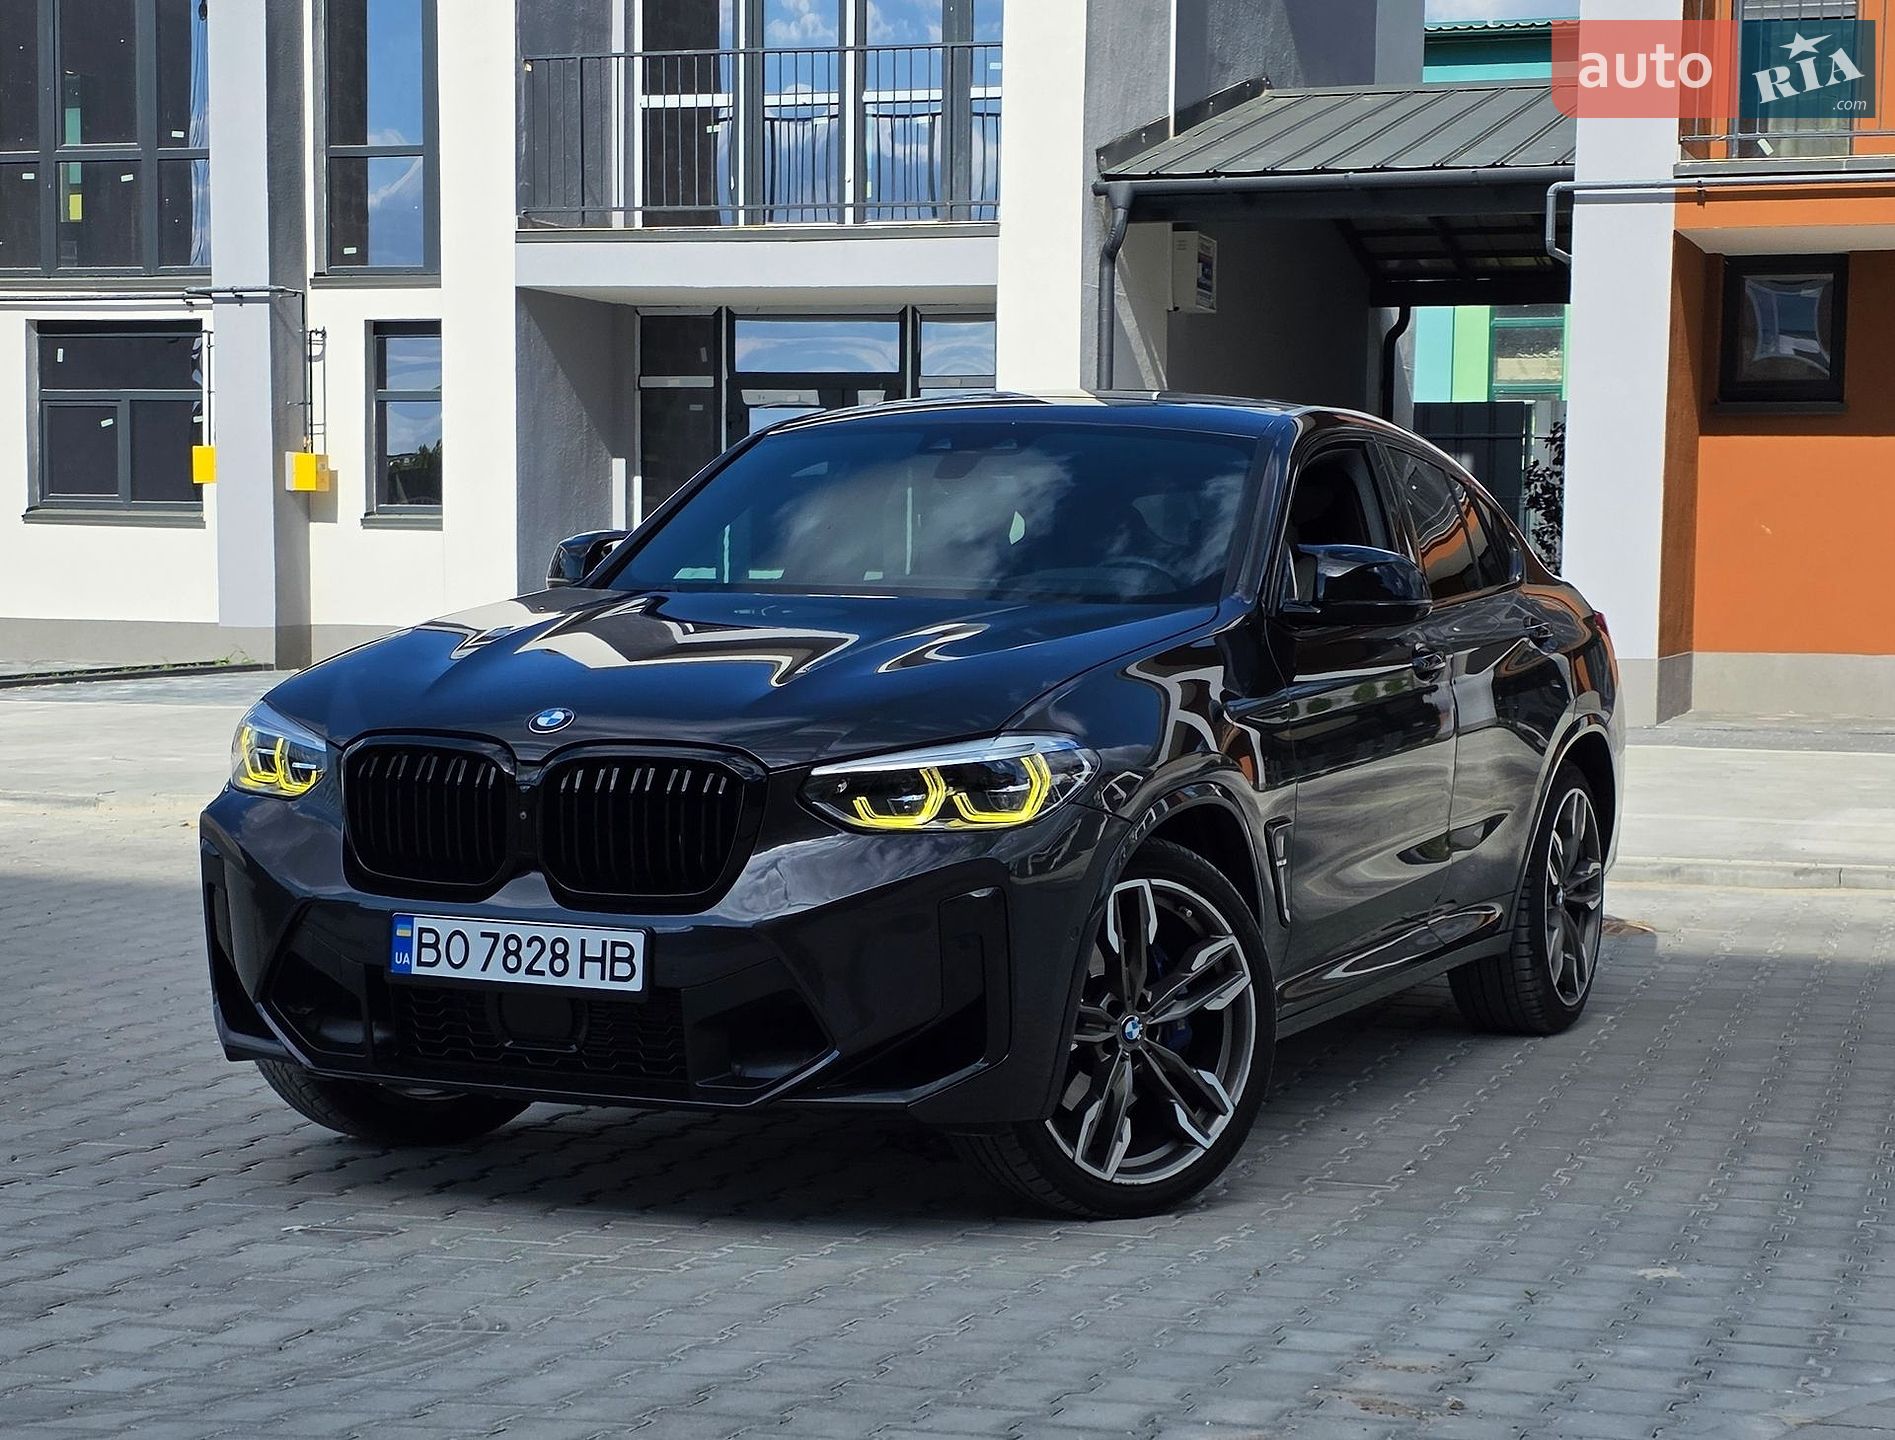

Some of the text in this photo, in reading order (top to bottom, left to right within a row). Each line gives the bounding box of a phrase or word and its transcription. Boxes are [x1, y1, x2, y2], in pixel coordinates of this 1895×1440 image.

[395, 952, 410, 966] UA
[416, 926, 637, 983] BO 7828 HB
